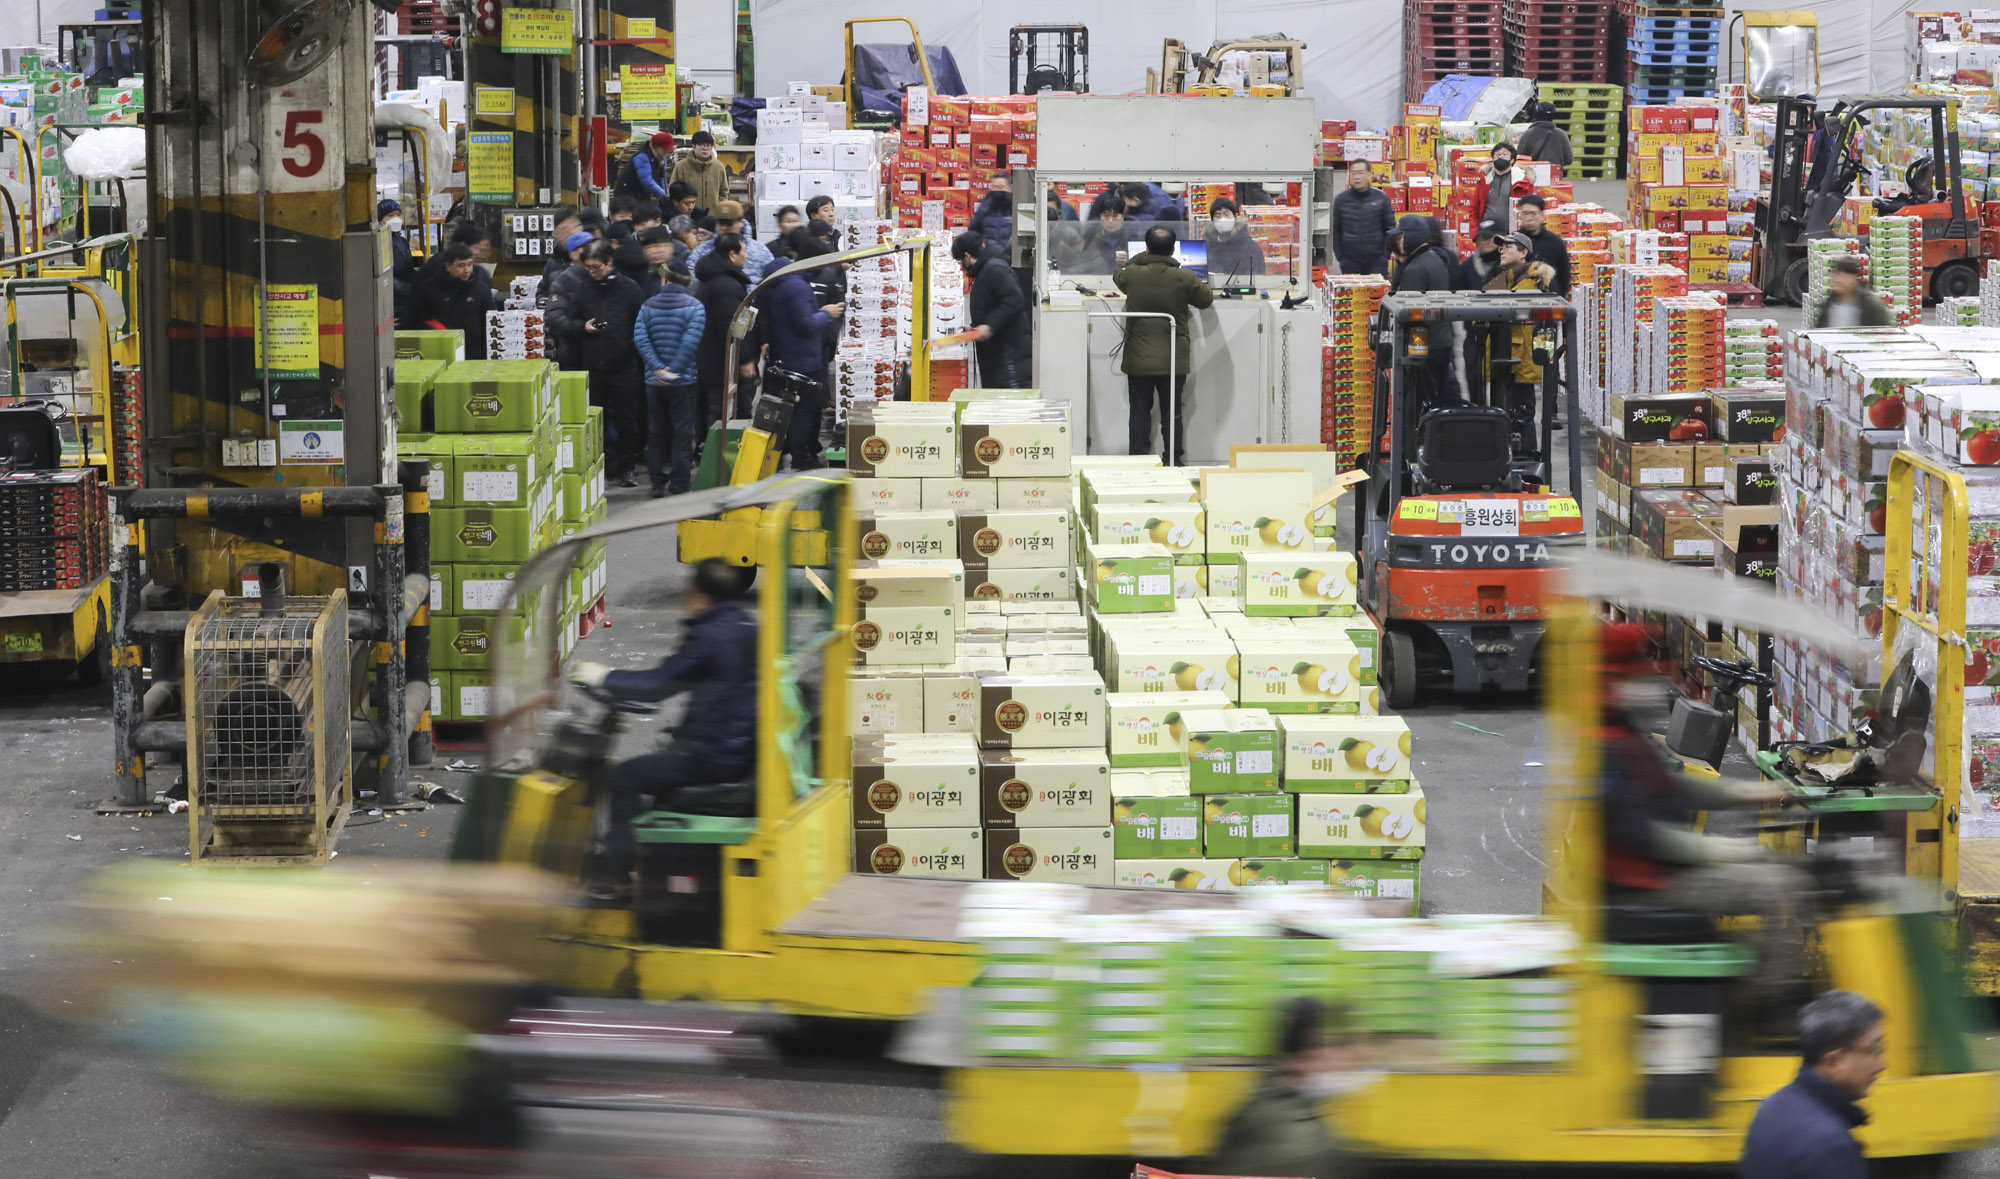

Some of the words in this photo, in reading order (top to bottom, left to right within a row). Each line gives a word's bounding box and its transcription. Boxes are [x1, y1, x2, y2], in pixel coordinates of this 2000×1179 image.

[281, 110, 326, 178] 5
[1641, 415, 1672, 424] 양구사과
[1745, 416, 1776, 424] 양구사과
[902, 446, 940, 460] 이광회
[1015, 446, 1055, 460] 이광회
[1413, 505, 1424, 514] 10
[1559, 502, 1569, 512] 10
[1465, 508, 1517, 528] 흥원상회
[903, 540, 942, 555] 이광회
[1014, 535, 1055, 551] 이광회
[1231, 535, 1249, 547] 배
[1430, 543, 1550, 563] TOYOTA
[1270, 586, 1288, 598] 배
[895, 629, 939, 645] 이광회
[1144, 682, 1164, 692] 배
[1266, 682, 1286, 695] 배
[1042, 710, 1089, 727] 이광회
[1137, 733, 1158, 746] 배
[1212, 761, 1231, 774] 배
[1311, 758, 1332, 772] 배
[916, 790, 963, 807] 이광회
[1047, 790, 1093, 806] 이광회
[1136, 827, 1155, 840] 배
[1229, 826, 1247, 838] 배
[1327, 824, 1348, 839] 배
[919, 854, 966, 871] 이광회
[1051, 854, 1097, 870] 이광회
